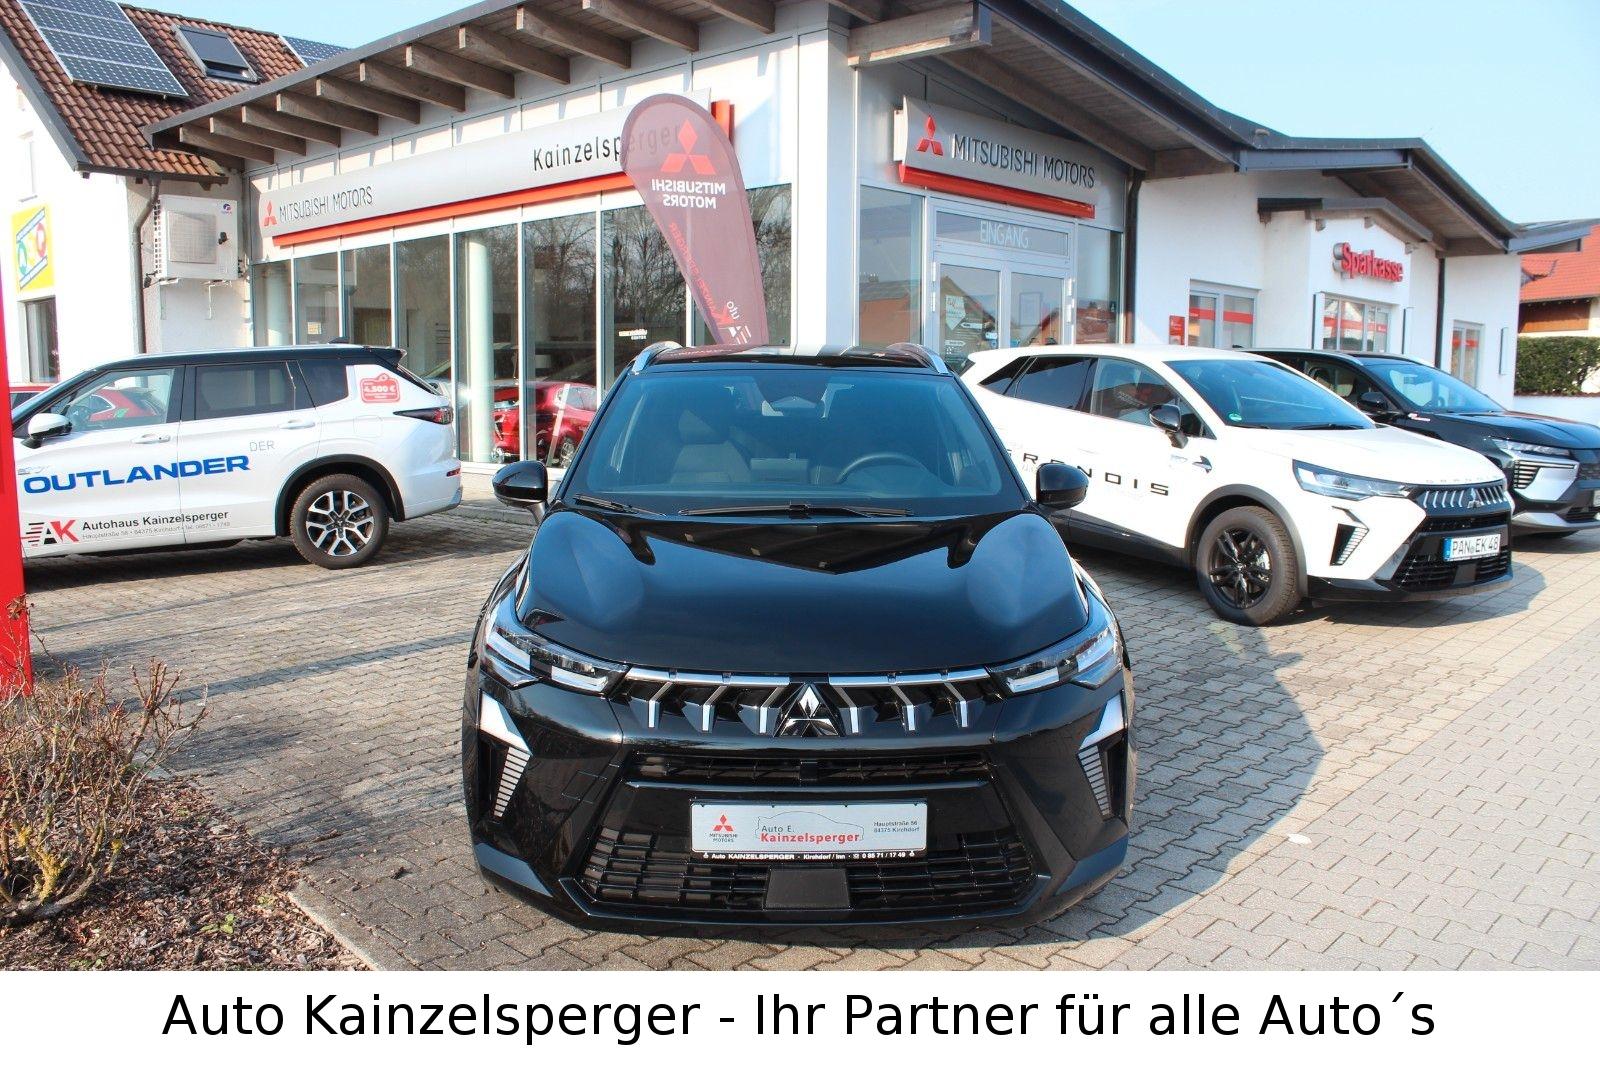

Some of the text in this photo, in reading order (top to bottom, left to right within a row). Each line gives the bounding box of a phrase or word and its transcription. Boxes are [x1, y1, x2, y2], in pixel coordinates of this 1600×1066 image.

[951, 132, 1095, 190] MITSUBISHI MOTORS
[279, 185, 374, 224] MITSUBISHI MOTORS
[980, 219, 1029, 249] EINGANG
[1333, 241, 1403, 282] Sparkasse
[250, 440, 275, 452] DER
[24, 455, 250, 494] OUTLANDER
[82, 511, 229, 531] Autohaus Kainzelsperger
[1452, 540, 1471, 556] PAN
[1475, 537, 1489, 553] EK
[761, 825, 795, 833] Auto E.
[761, 832, 860, 844] Kainzelsperger
